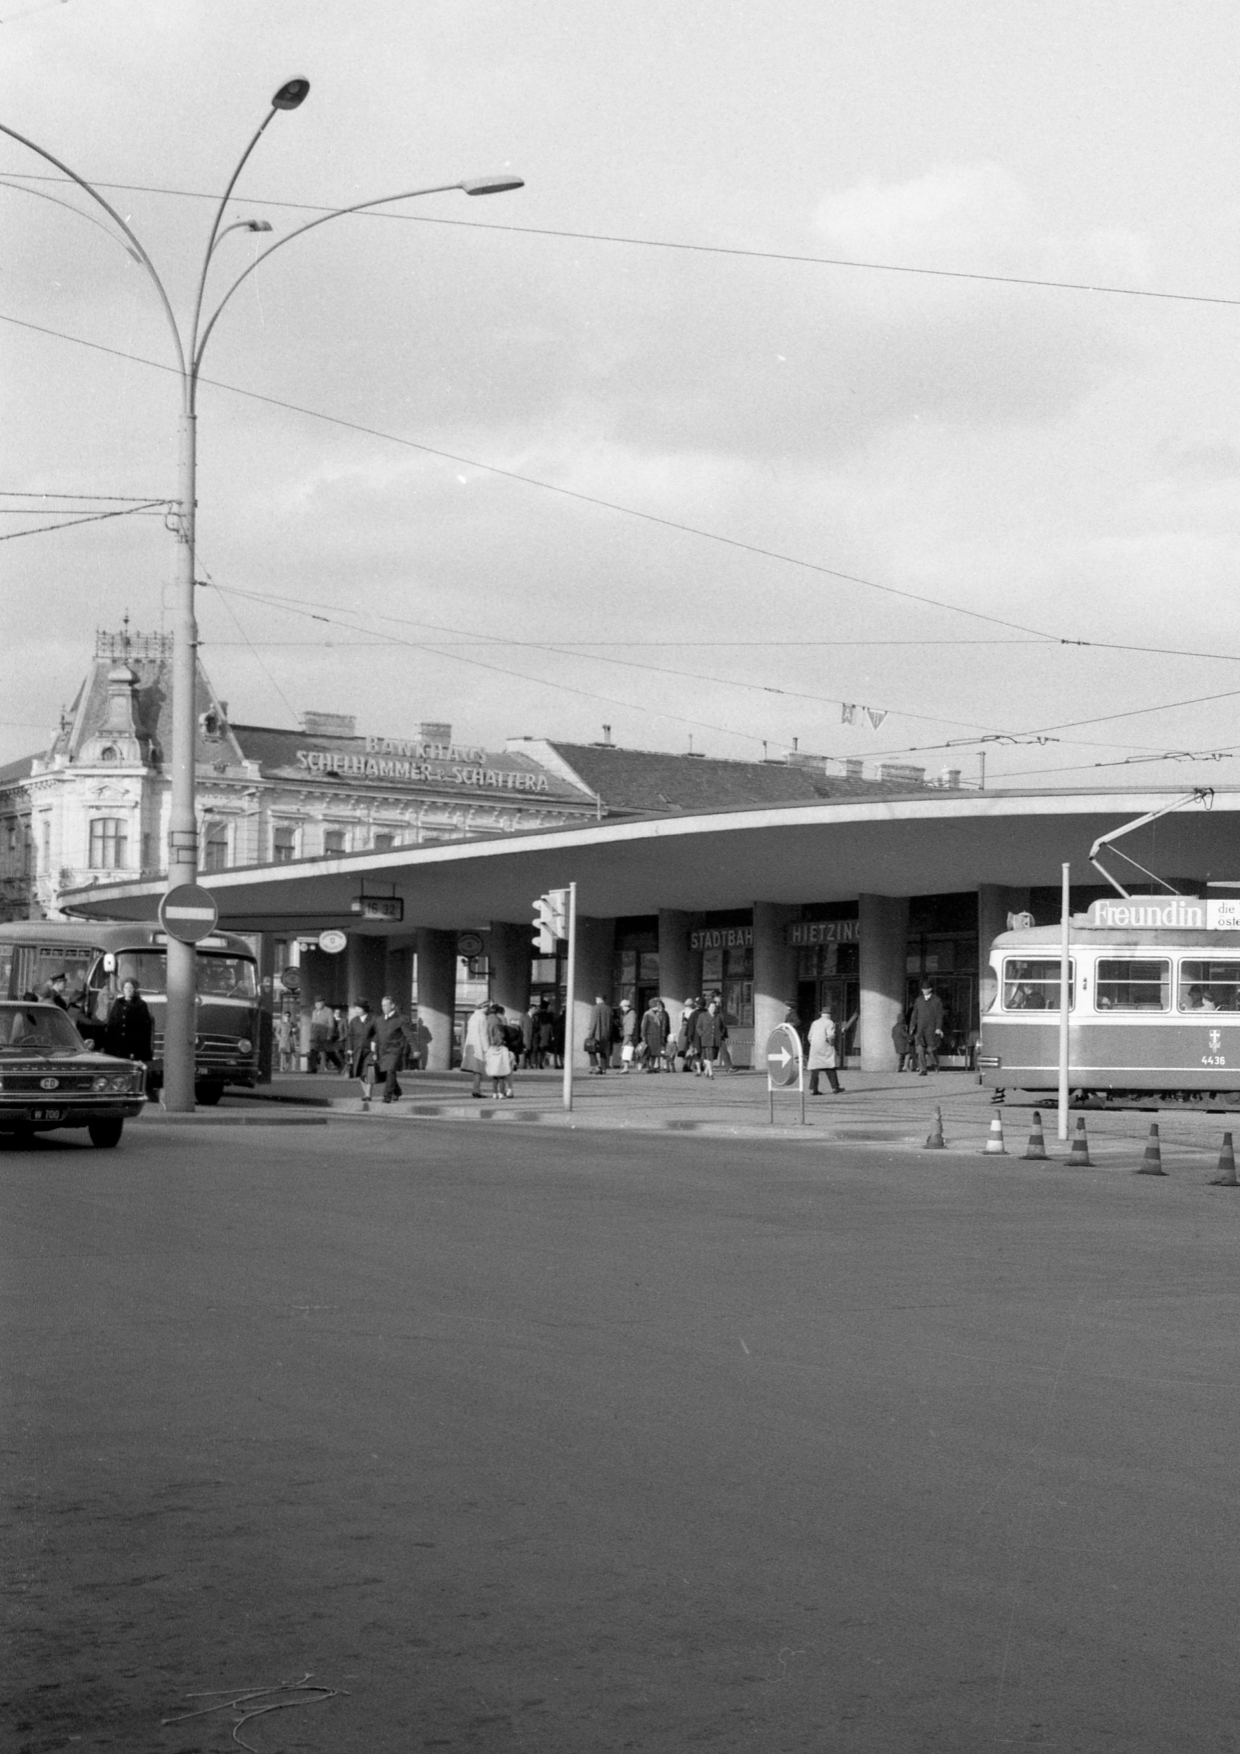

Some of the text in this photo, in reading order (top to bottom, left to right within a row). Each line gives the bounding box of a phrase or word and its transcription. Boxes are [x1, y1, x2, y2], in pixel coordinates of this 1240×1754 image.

[366, 736, 487, 764] BANKHAUS
[296, 750, 431, 781] SCHELHAMMER
[453, 766, 549, 792] SCHATTERA
[1093, 900, 1203, 927] Freundin
[1217, 901, 1235, 914] die
[1201, 1056, 1226, 1065] 4436
[45, 1109, 60, 1119] 700
